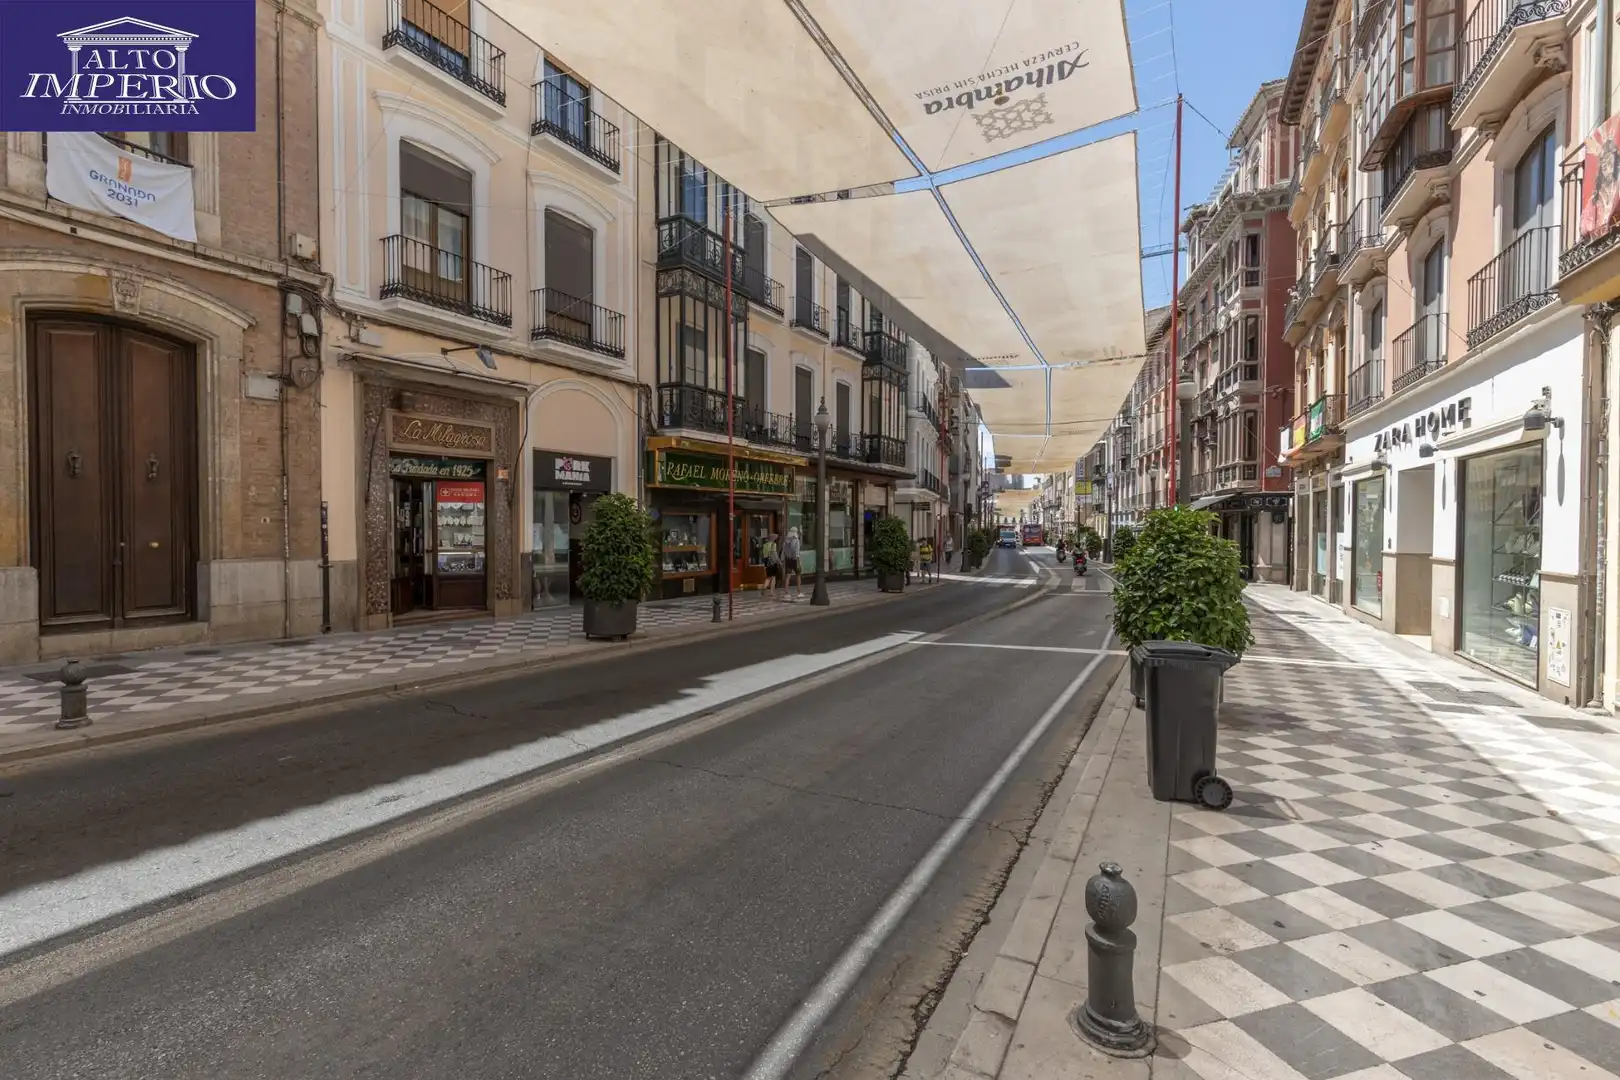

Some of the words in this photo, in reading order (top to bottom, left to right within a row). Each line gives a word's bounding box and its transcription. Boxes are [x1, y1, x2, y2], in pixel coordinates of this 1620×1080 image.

[1022, 41, 1080, 67] CERVEZA
[923, 48, 1090, 116] Alhambra
[977, 62, 1019, 82] HECHA
[914, 84, 950, 101] PRISA
[954, 76, 976, 90] SIN
[89, 169, 157, 202] GRANADA
[107, 188, 139, 209] 2031
[400, 420, 422, 440] La
[423, 423, 486, 448] Milagrosa
[1373, 422, 1412, 453] ZARA
[1415, 396, 1472, 438] HOME
[439, 466, 451, 477] en
[452, 464, 474, 478] 1925
[667, 461, 706, 480] RAFAEL
